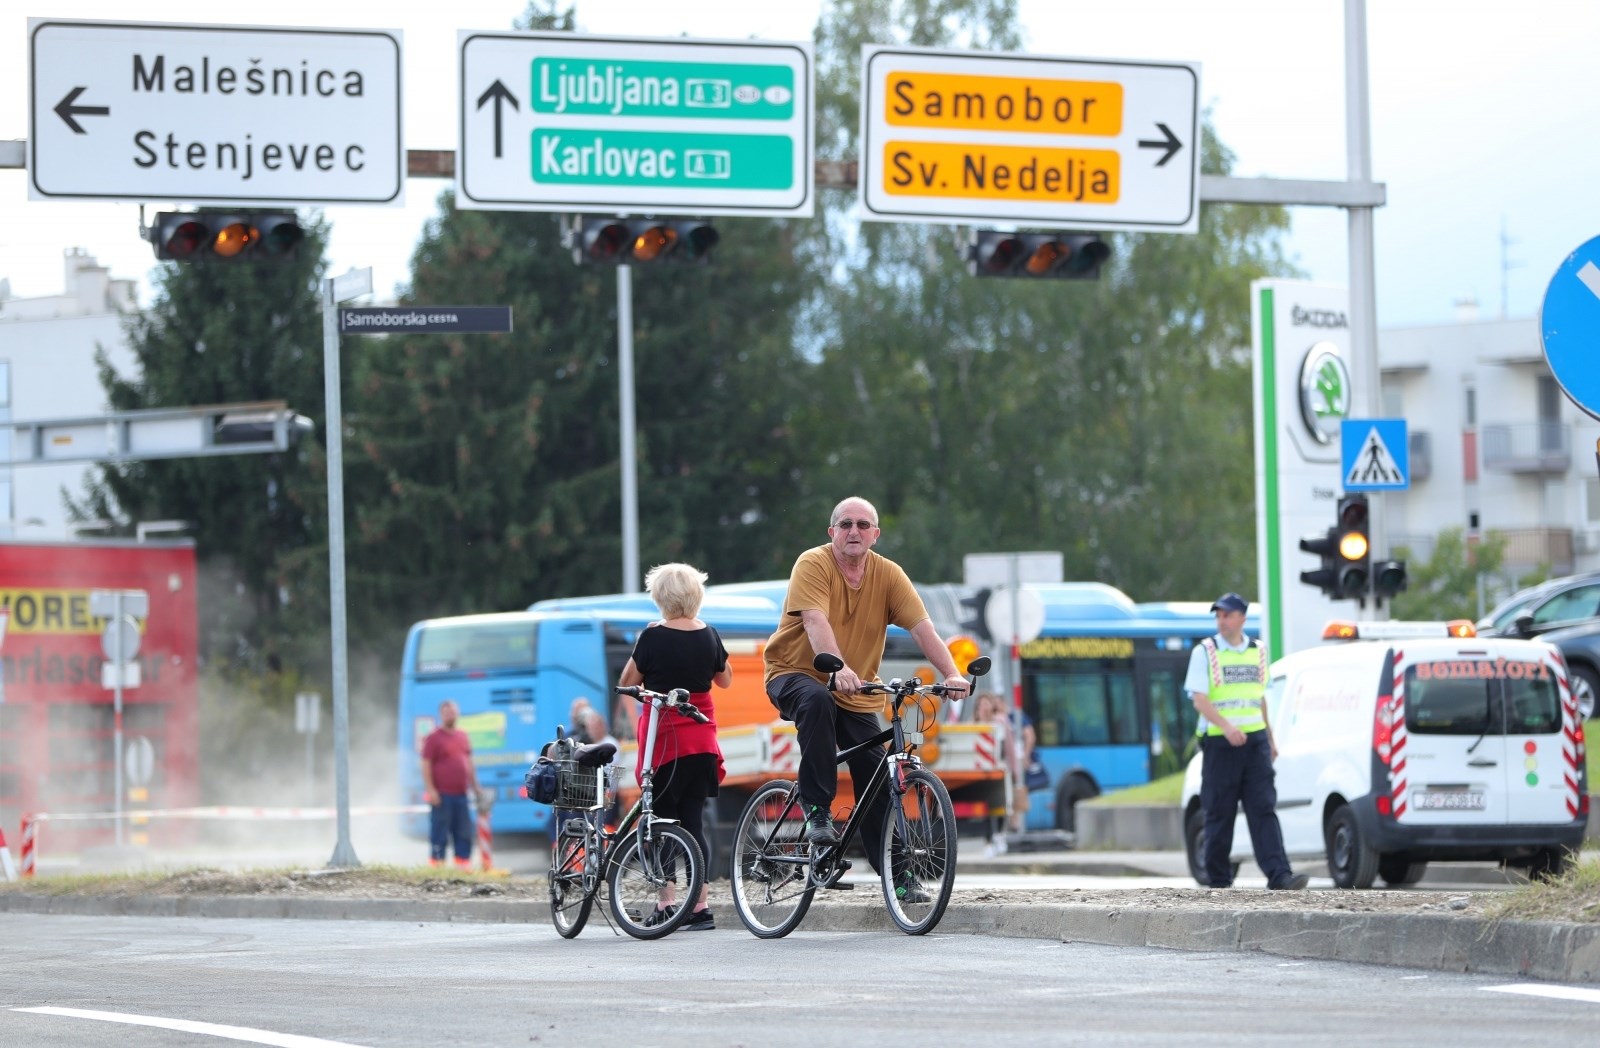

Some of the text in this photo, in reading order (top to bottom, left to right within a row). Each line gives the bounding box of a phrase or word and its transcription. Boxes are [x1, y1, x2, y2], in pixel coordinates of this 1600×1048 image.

[133, 54, 364, 97] Malešnica
[541, 63, 679, 114] Ljubljana
[893, 80, 1097, 123] Samobor
[133, 130, 365, 180] Stenjevec
[541, 135, 676, 178] Karlovac
[892, 151, 1110, 201] Sv. Nedelja
[346, 312, 459, 327] Samoborska CESTA
[1291, 304, 1349, 329] ŠKODA
[1416, 657, 1550, 680] semafori
